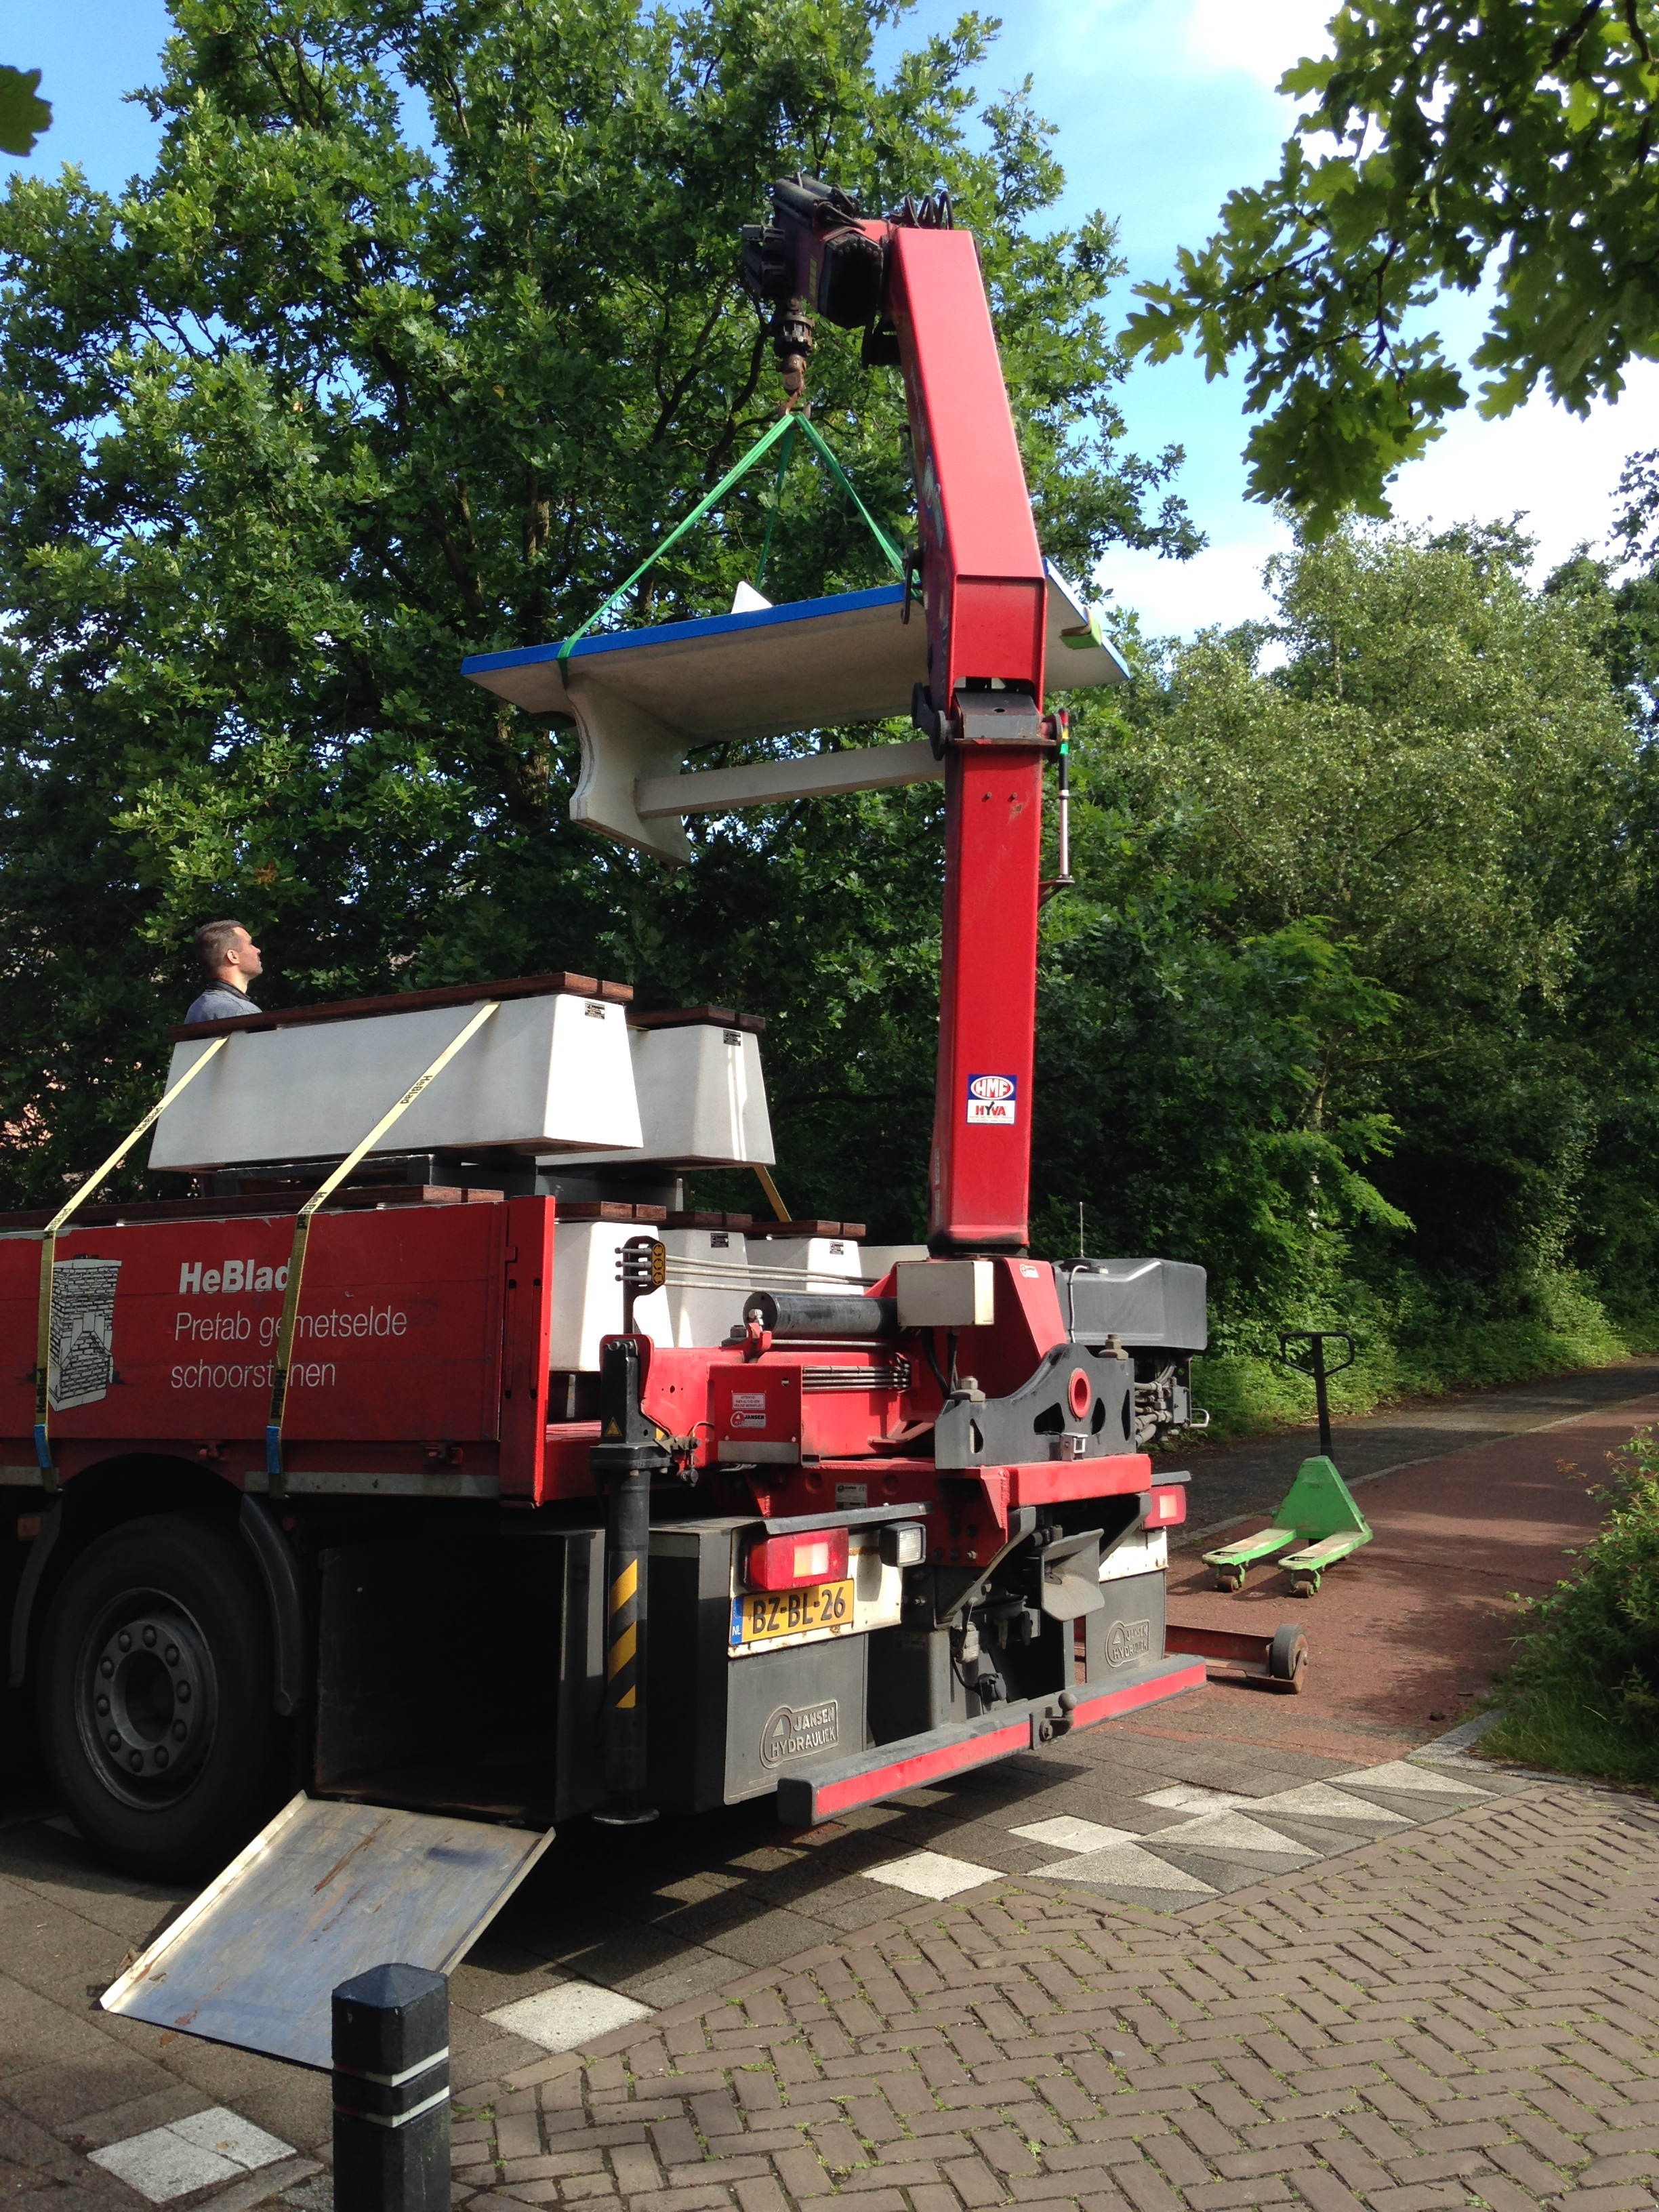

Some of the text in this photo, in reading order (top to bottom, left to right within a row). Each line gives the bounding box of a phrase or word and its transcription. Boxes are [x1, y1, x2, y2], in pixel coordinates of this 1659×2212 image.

[399, 1075, 434, 1105] HeBlad
[975, 1078, 1008, 1099] HMF
[975, 1101, 1006, 1116] HYVA
[179, 1257, 291, 1294] HeBlad
[175, 1310, 251, 1341] Prefab
[171, 1359, 336, 1389] schoorstnen
[752, 1586, 846, 1635] BZ-BL-26
[731, 1624, 741, 1636] NL
[793, 1706, 834, 1732] JANSEN
[771, 1725, 836, 1758] HYDRAULIEK
